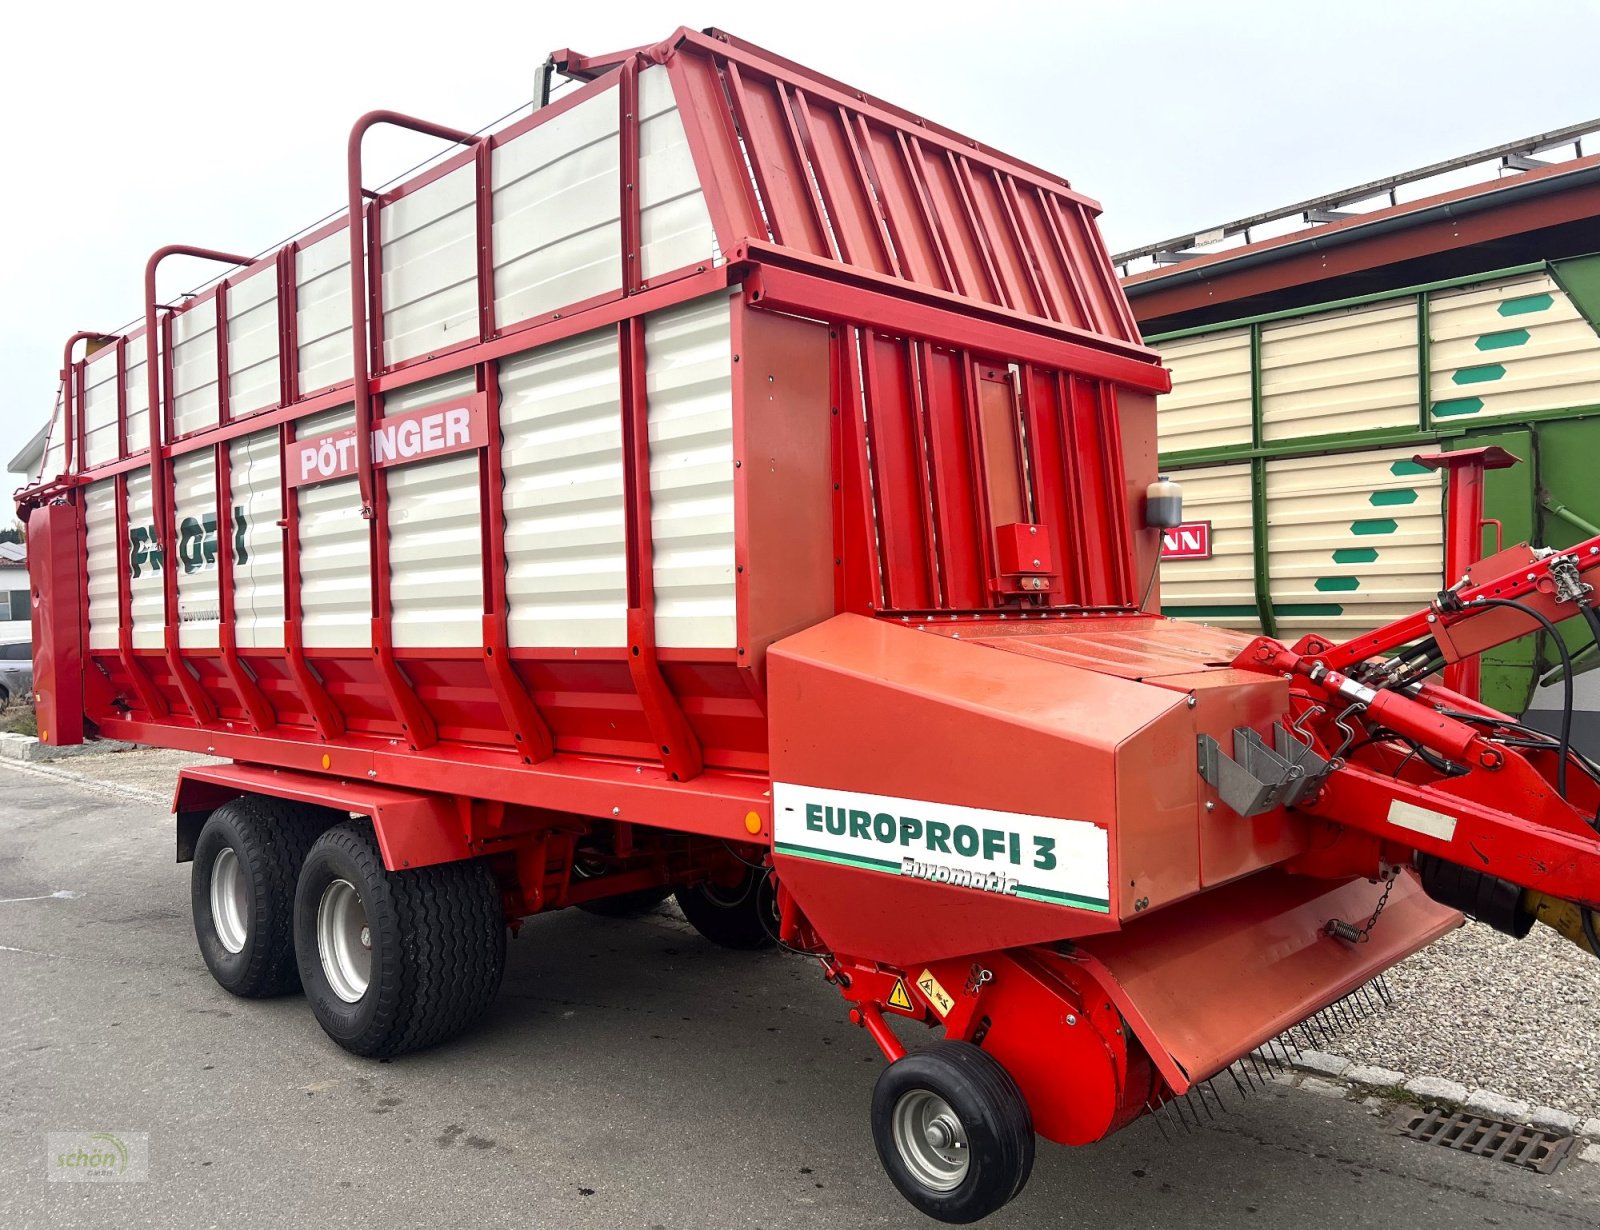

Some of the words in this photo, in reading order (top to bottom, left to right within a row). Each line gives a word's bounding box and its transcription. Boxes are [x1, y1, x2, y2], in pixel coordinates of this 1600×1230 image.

[805, 803, 1021, 865] EUROPROFI
[1033, 835, 1057, 870] 3
[900, 857, 1019, 897] Euromatic
